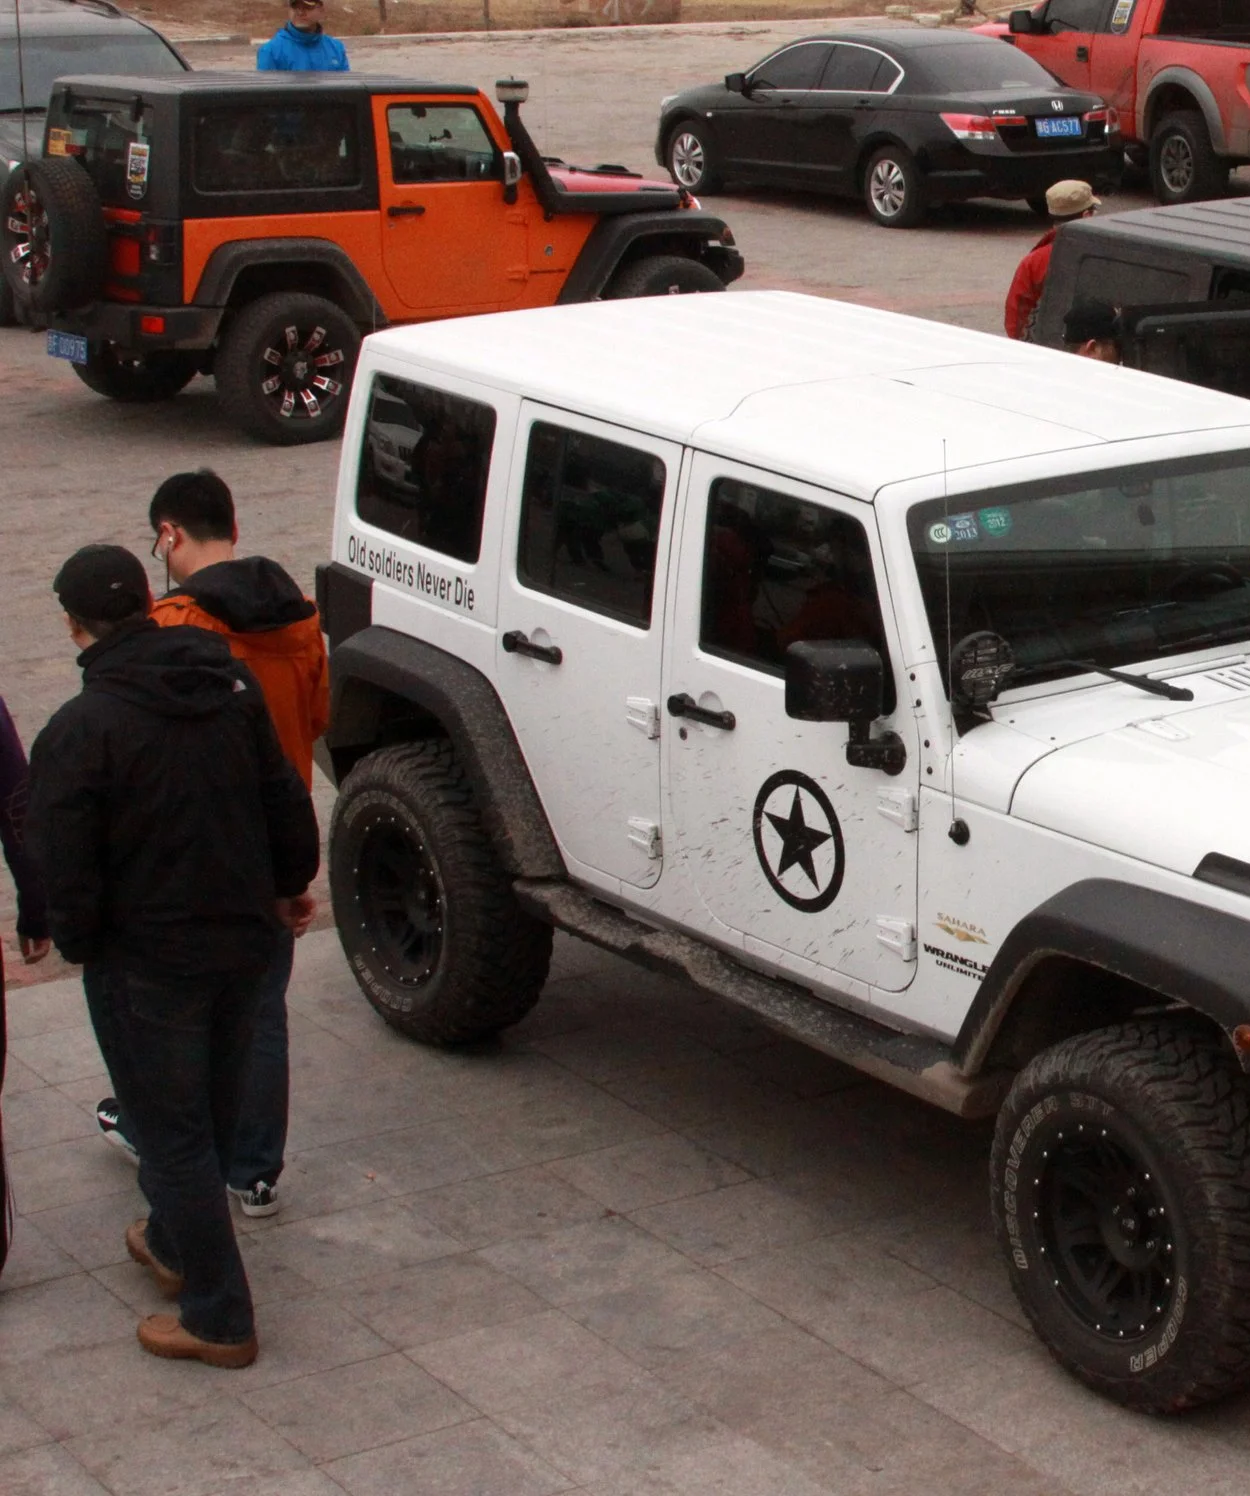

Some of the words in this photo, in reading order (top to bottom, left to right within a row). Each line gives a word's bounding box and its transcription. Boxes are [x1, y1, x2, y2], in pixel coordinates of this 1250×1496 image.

[348, 535, 367, 568] Old
[368, 548, 414, 587] soldiers
[416, 561, 452, 601] Never
[454, 576, 475, 611] Die
[936, 912, 987, 937] SAHARA
[923, 943, 991, 975] WRANGLE
[935, 959, 986, 982] UNLIMITE
[1003, 1094, 1059, 1270] DISCOVERER
[1129, 1275, 1188, 1373] COOPER
